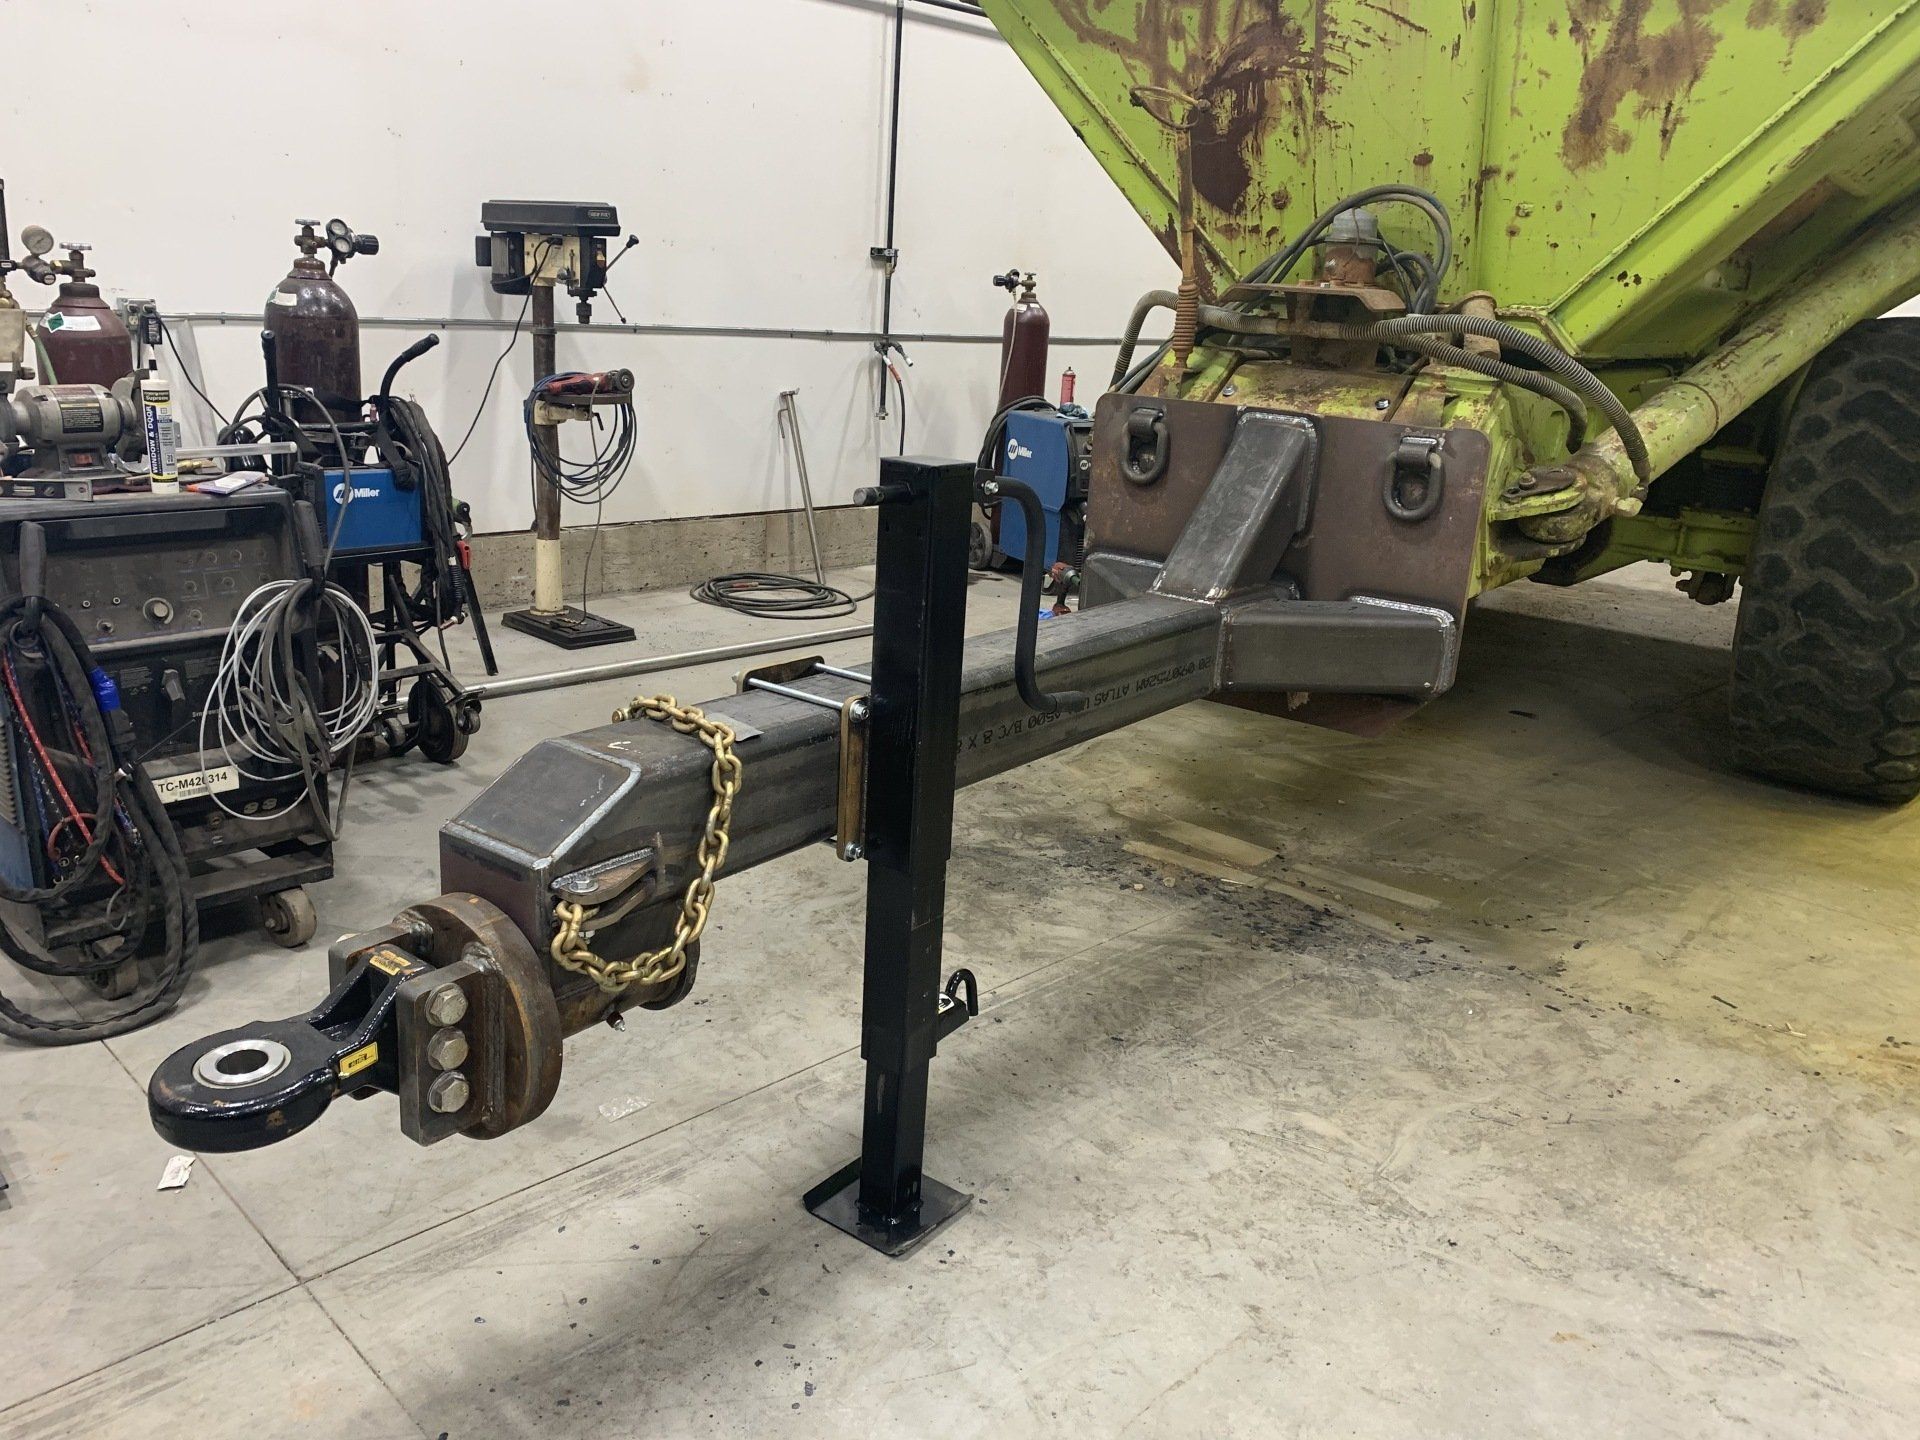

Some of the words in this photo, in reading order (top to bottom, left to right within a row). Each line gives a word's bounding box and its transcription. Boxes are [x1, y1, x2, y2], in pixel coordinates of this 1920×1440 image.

[149, 440, 159, 473] WINDOW
[354, 487, 380, 498] Miller
[1094, 683, 1130, 706] ATLAS
[983, 729, 993, 744] 8
[998, 720, 1022, 739] B/C
[968, 734, 978, 750] X
